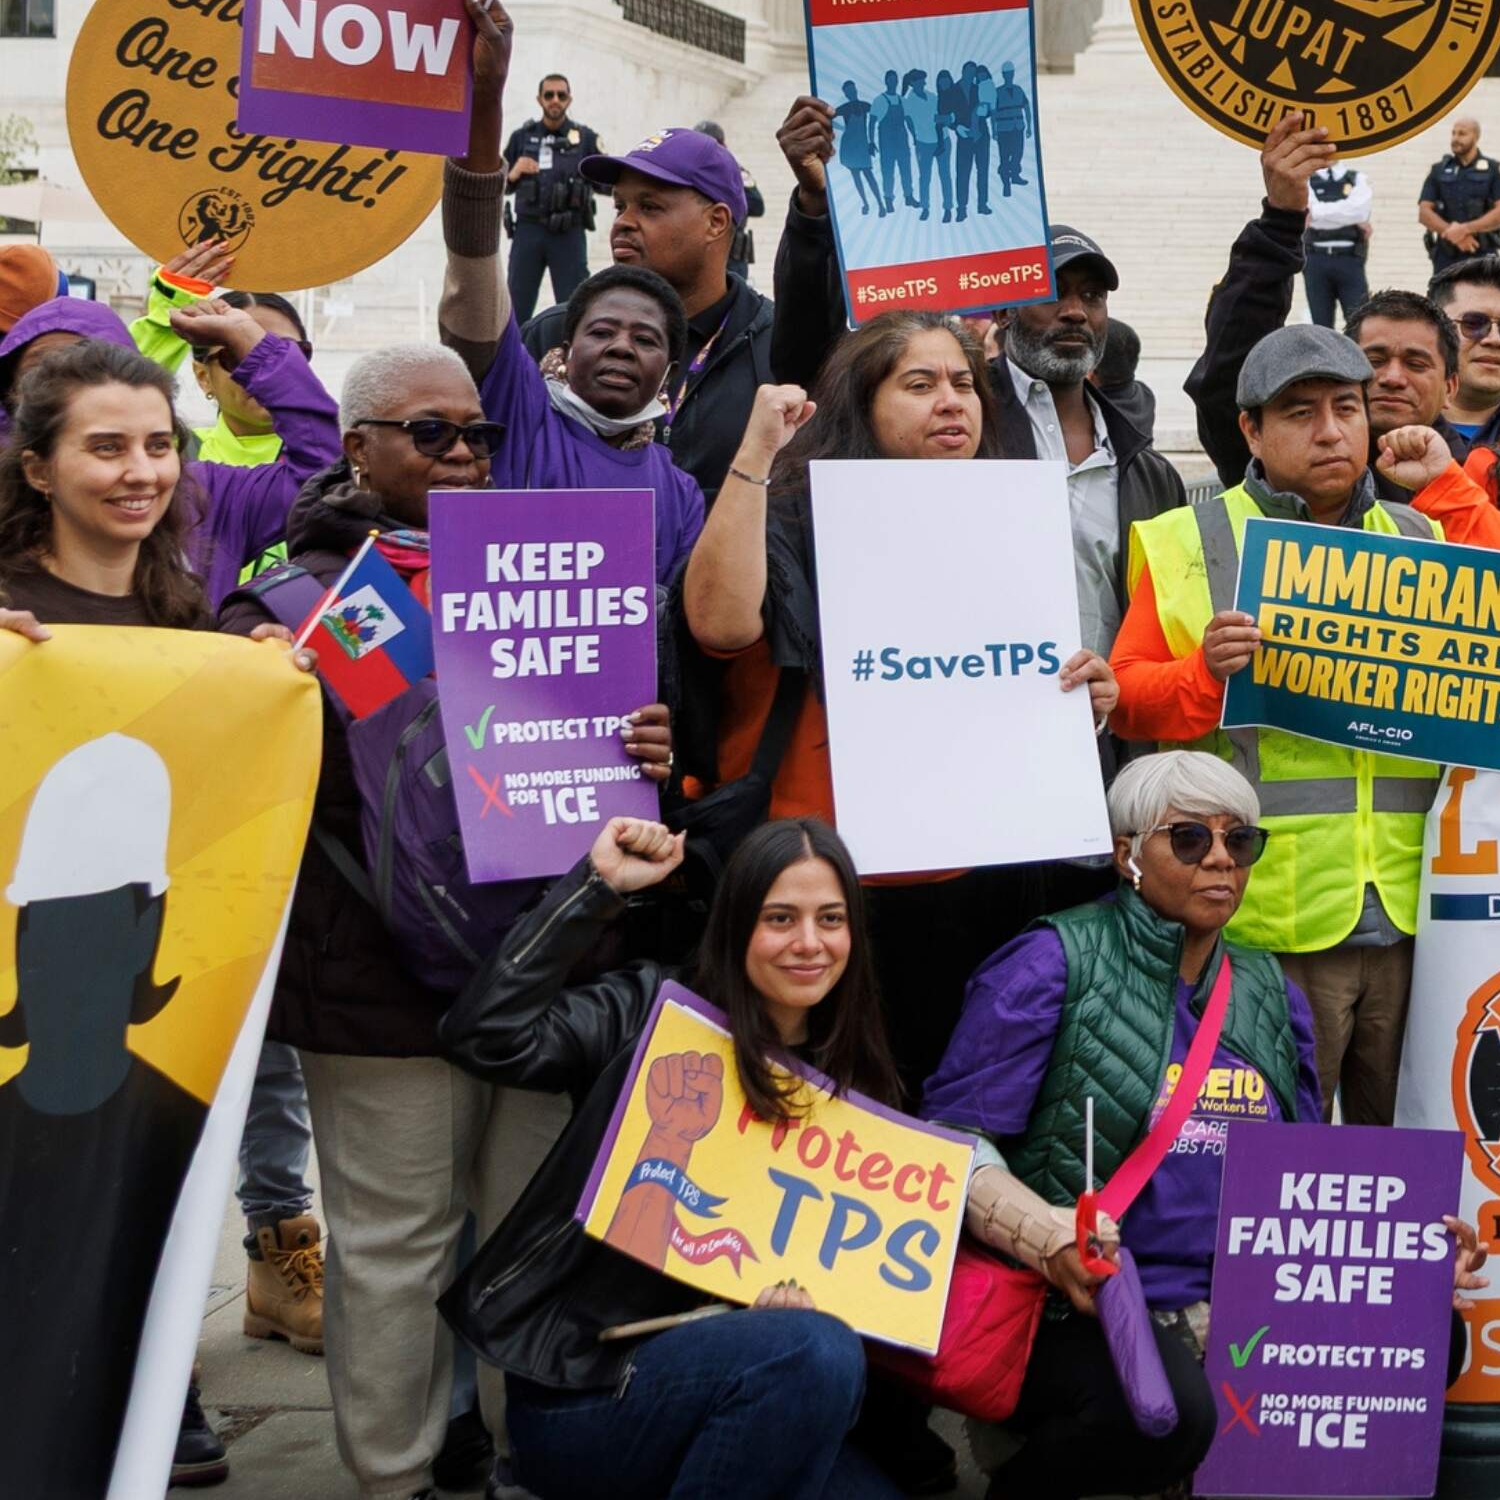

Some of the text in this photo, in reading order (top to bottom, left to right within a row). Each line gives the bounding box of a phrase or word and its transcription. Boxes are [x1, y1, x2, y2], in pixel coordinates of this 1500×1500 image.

[116, 17, 217, 89] One
[1336, 84, 1414, 136] 1887
[97, 88, 408, 209] One Fight!
[856, 263, 1043, 304] #SaveTPS #SoveTPS
[485, 541, 605, 583] KEEP
[441, 586, 649, 633] FAMILIES
[1272, 612, 1422, 657] RIGHTS
[491, 634, 601, 679] SAFE
[851, 641, 1061, 682] #SaveTPS
[1252, 645, 1400, 710] WORKER
[493, 715, 634, 744] PROTECT TPS
[1346, 721, 1414, 740] AFL-CIO
[504, 765, 641, 789] NO MORE FUNDING
[507, 786, 600, 825] FOR ICE
[1199, 1100, 1247, 1114] Workers
[1247, 1101, 1268, 1115] East
[678, 1175, 701, 1206] TPS
[1279, 1172, 1407, 1213] KEEP
[768, 1166, 941, 1293] TPS
[1227, 1215, 1449, 1262] FAMILIES
[1274, 1264, 1394, 1305] SAFE
[1262, 1343, 1425, 1370] PROTECT TPS
[1260, 1393, 1427, 1413] NO MORE FUNDING
[1260, 1409, 1368, 1449] FOR ICE
